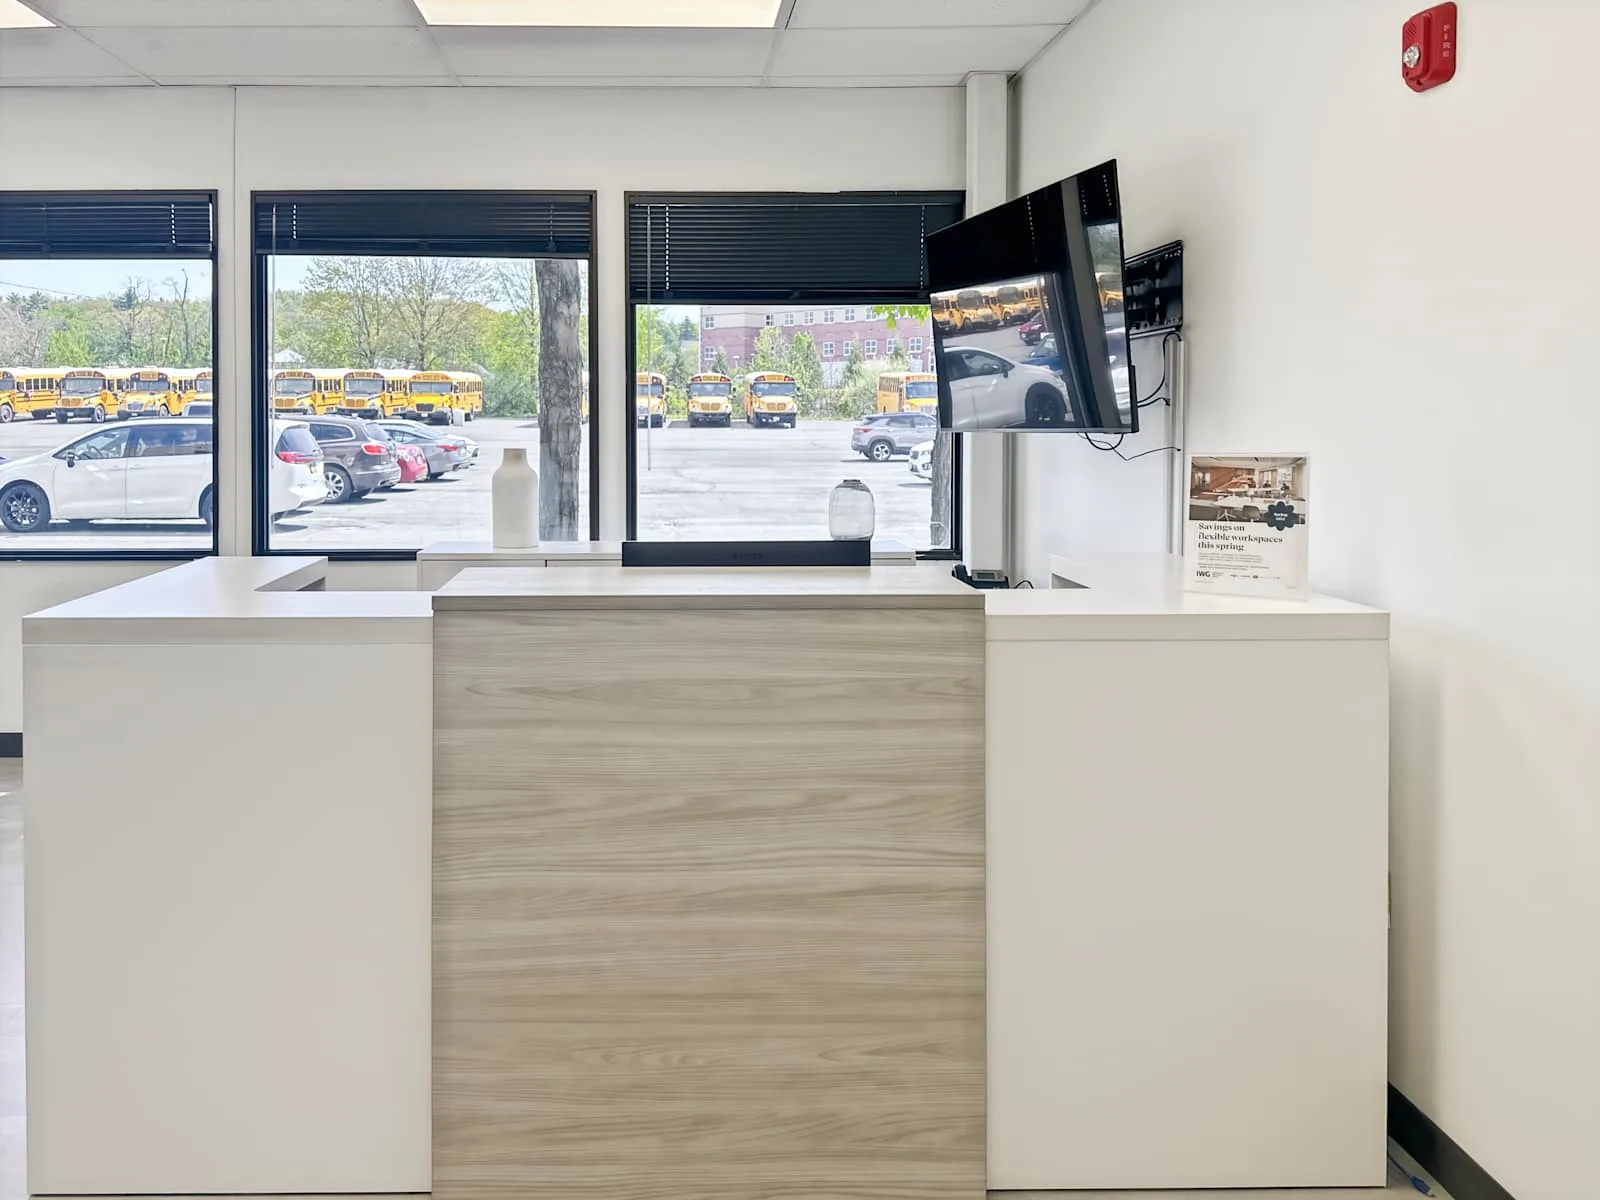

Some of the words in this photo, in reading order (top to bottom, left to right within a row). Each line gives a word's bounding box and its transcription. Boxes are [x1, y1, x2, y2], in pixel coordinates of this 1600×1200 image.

[1443, 24, 1451, 57] FIRE
[1198, 522, 1232, 531] Savings
[1198, 532, 1230, 541] flexible
[1231, 534, 1283, 543] workspaces
[1198, 541, 1214, 549] this
[1216, 542, 1245, 551] spring
